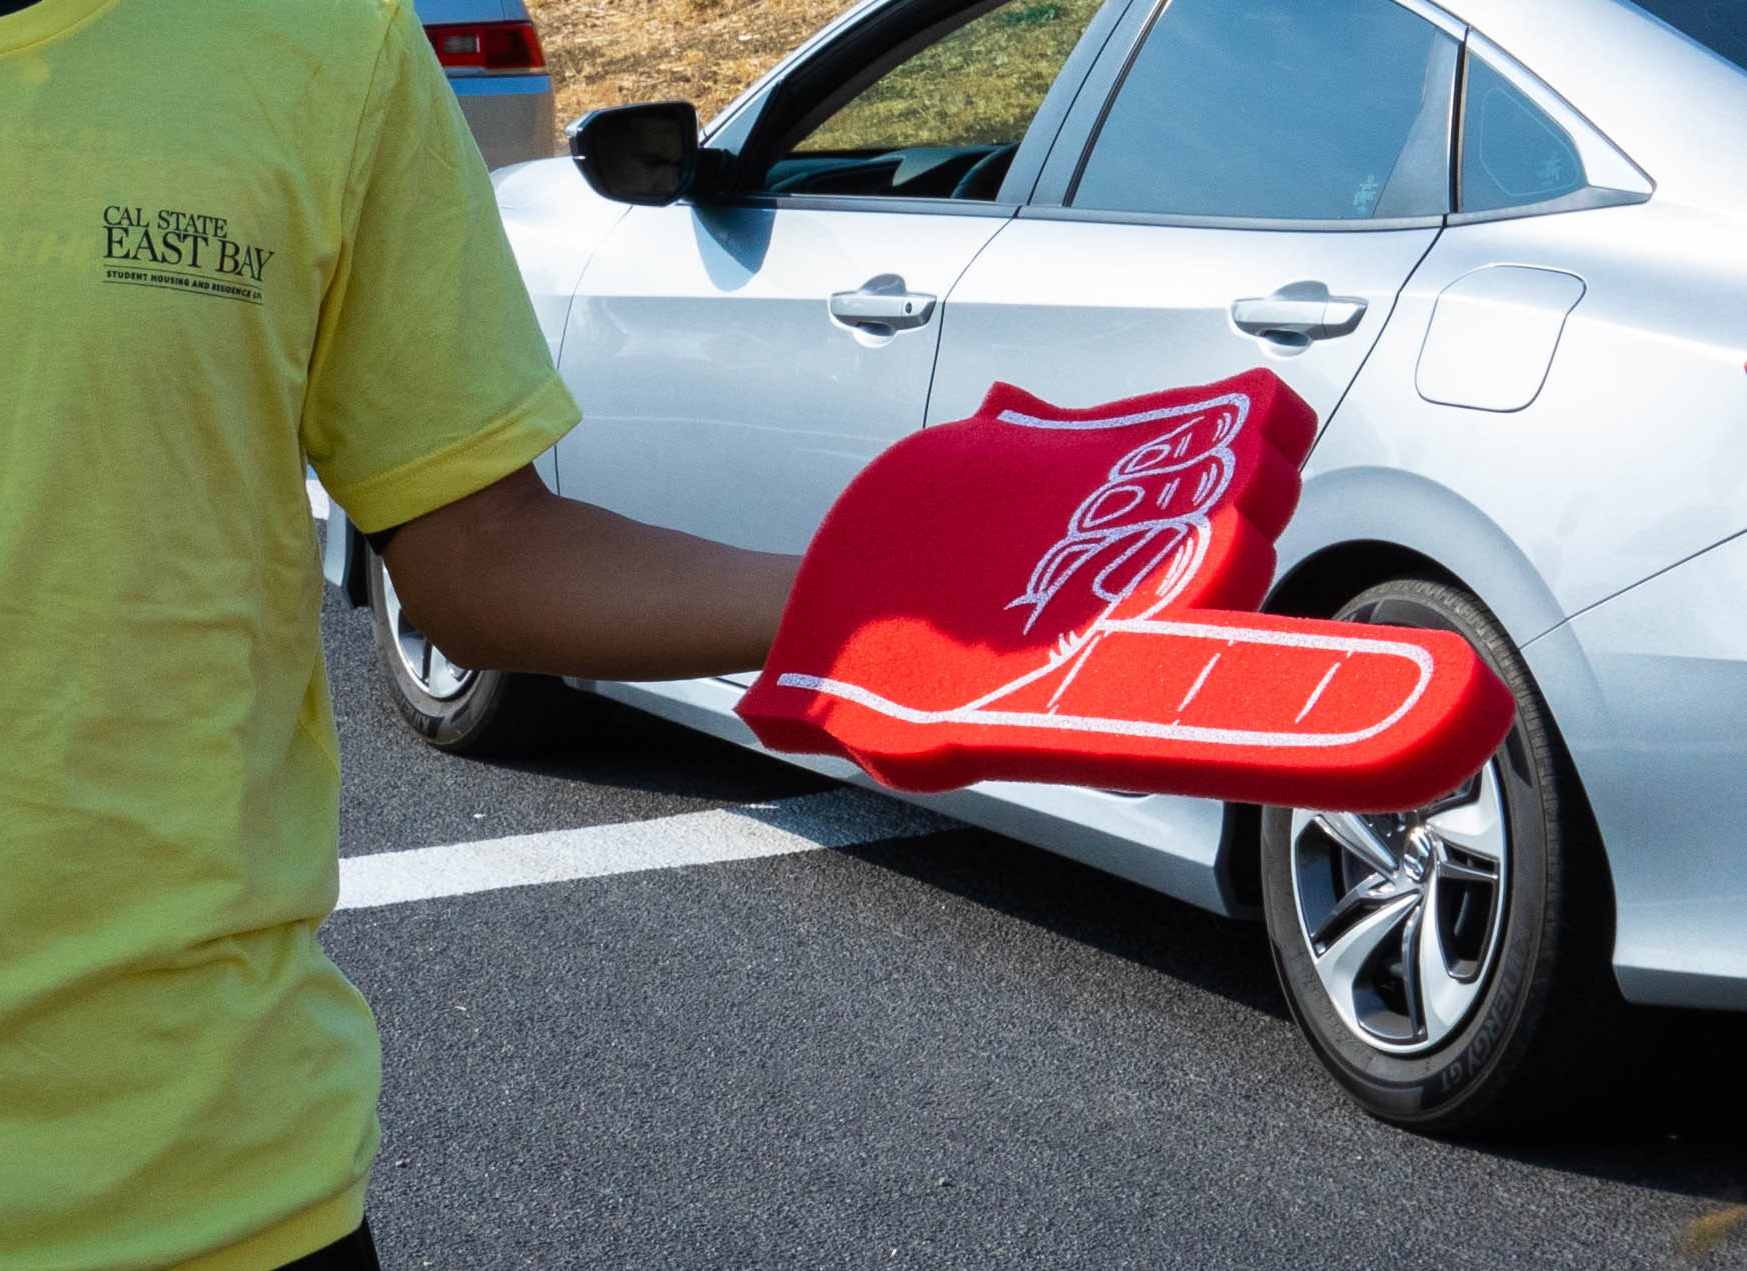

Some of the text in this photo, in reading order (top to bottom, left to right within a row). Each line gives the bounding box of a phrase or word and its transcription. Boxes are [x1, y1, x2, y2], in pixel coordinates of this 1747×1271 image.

[103, 206, 228, 238] CAL STATE
[103, 226, 275, 281] EAST BAY
[106, 270, 148, 281] STUDENT
[151, 274, 190, 286] HOUSING
[192, 280, 210, 290] AND
